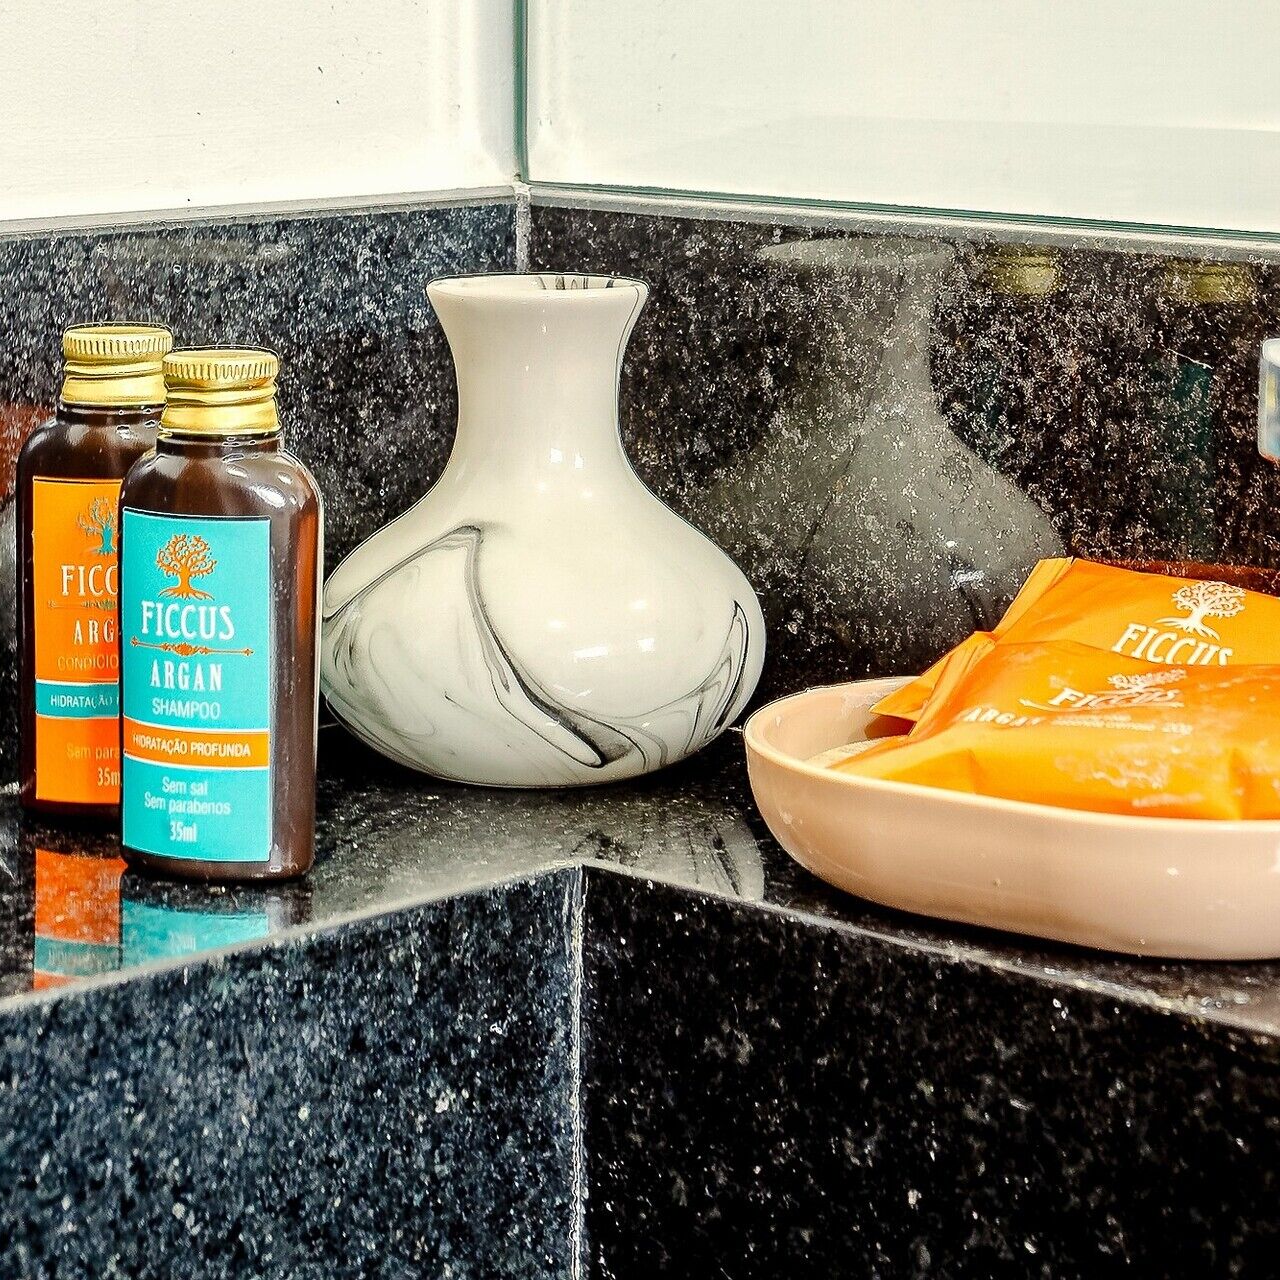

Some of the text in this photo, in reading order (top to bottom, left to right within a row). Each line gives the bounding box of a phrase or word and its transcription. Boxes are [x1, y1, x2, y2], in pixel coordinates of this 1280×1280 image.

[61, 563, 118, 596] FICC
[74, 619, 114, 645] ARG
[141, 600, 235, 640] FICCUS
[150, 659, 223, 691] ARGAN
[152, 698, 221, 719] SHAMPOO
[133, 732, 188, 755] HIDRATAÇÃO
[190, 741, 251, 757] PROFUNDA
[162, 776, 208, 796] Sem sal
[144, 791, 231, 815] Sem parabenos
[169, 821, 197, 842] 35ml
